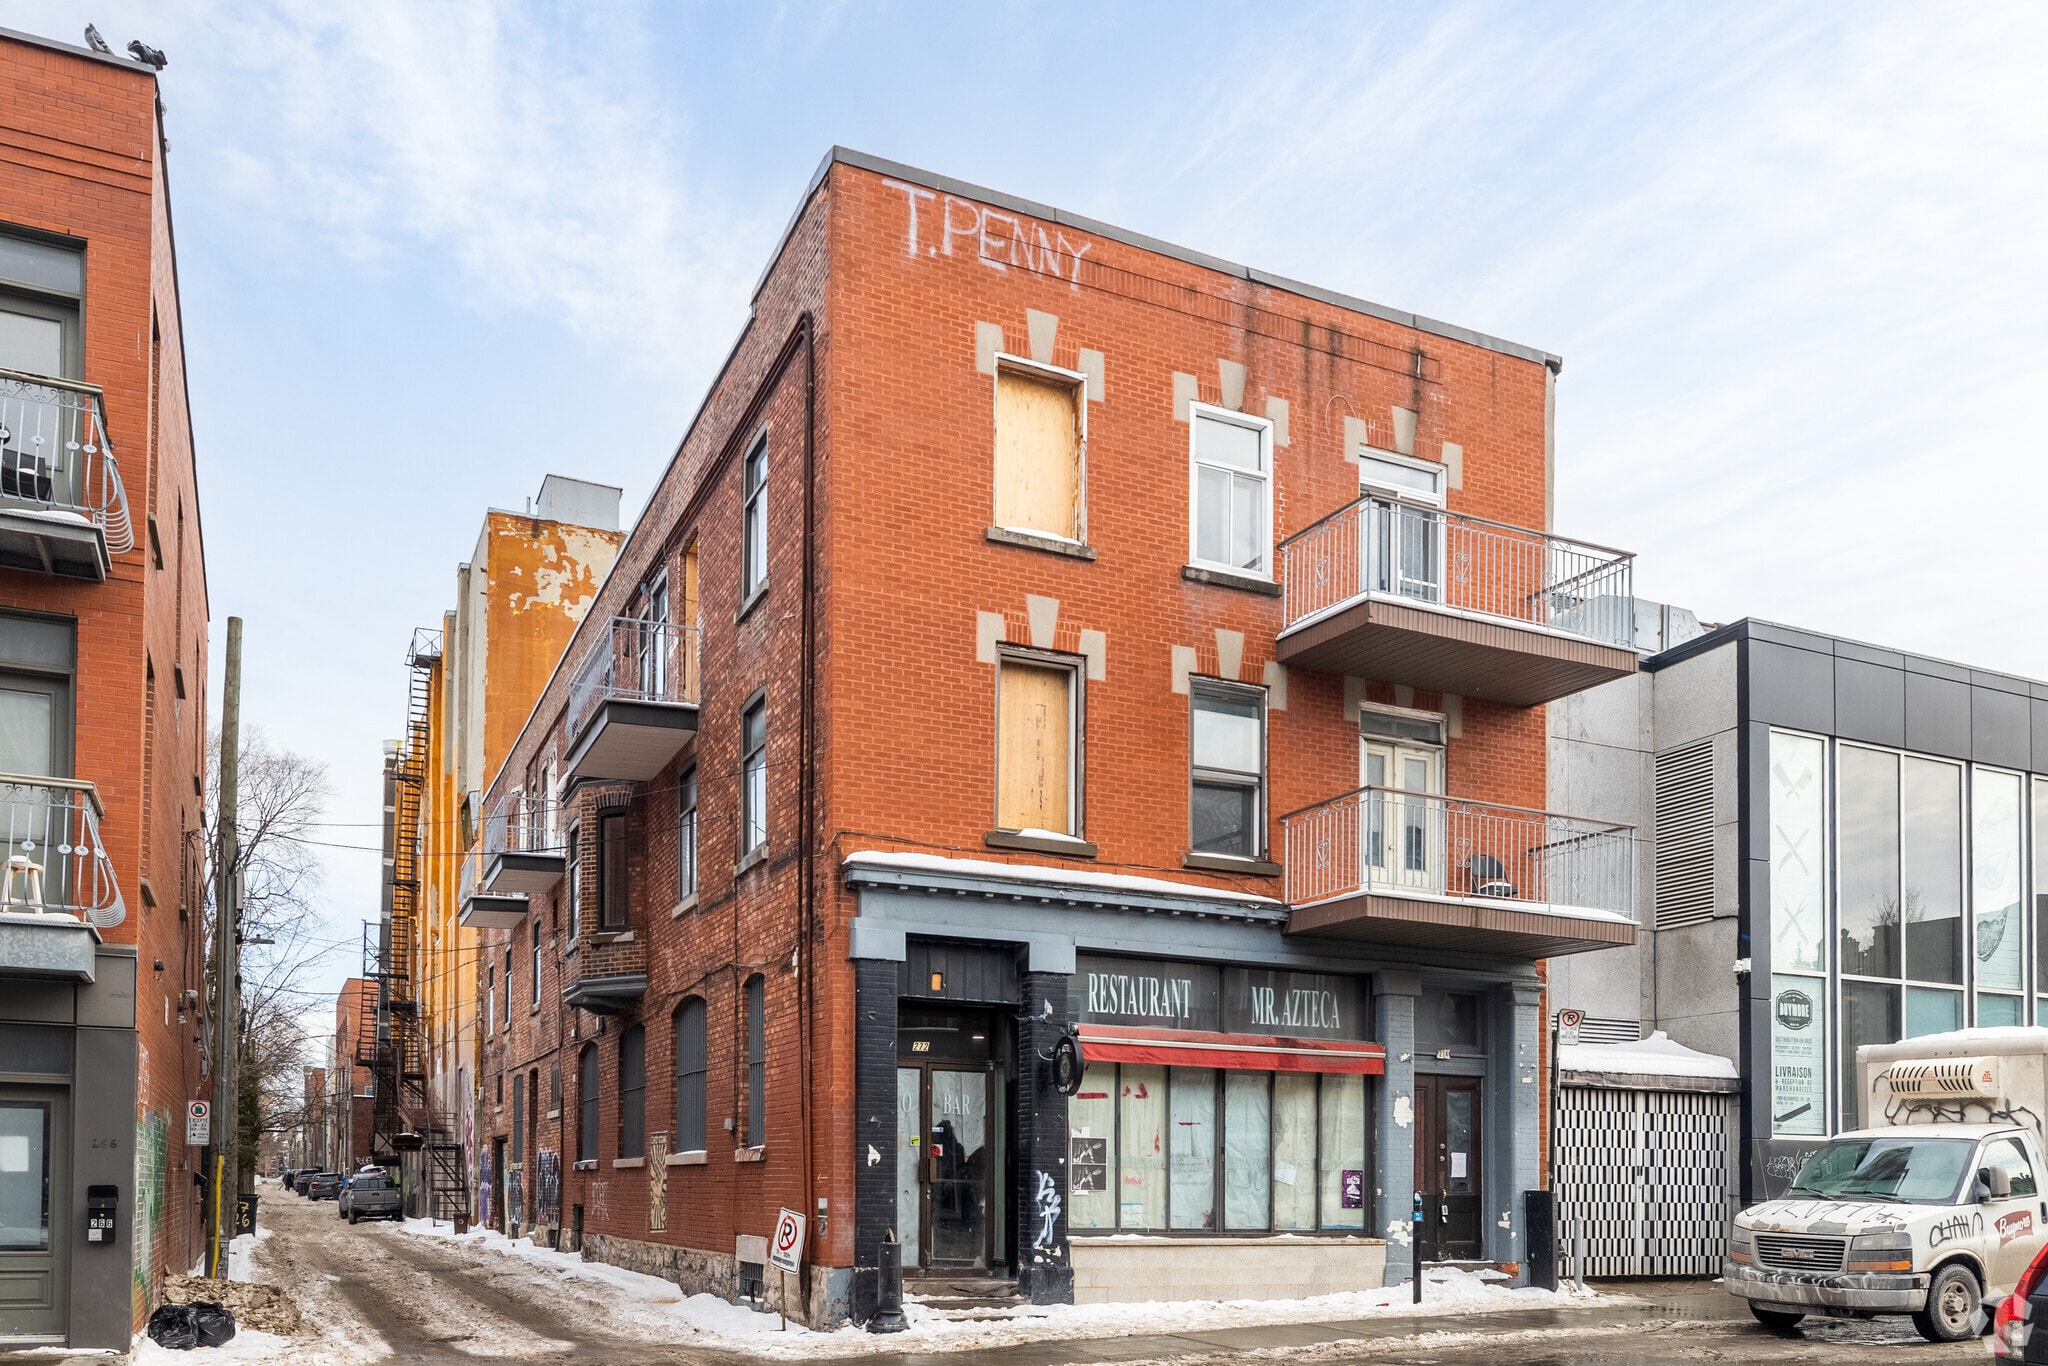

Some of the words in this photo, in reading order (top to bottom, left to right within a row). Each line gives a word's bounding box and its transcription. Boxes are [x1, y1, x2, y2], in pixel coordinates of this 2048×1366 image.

[882, 179, 1092, 291] T.PENNY
[1088, 973, 1191, 1018] RESTAURANT
[1251, 986, 1279, 1026] MR.
[1281, 990, 1341, 1029] AZTECA
[1780, 1003, 1809, 1017] BUYMORE
[913, 1042, 930, 1051] 272
[1775, 1066, 1812, 1078] LIVRAISON
[943, 1094, 970, 1115] BAR
[90, 1219, 113, 1228] 266
[2000, 1216, 2031, 1239] Buymore
[1781, 1248, 1814, 1259] GMC
